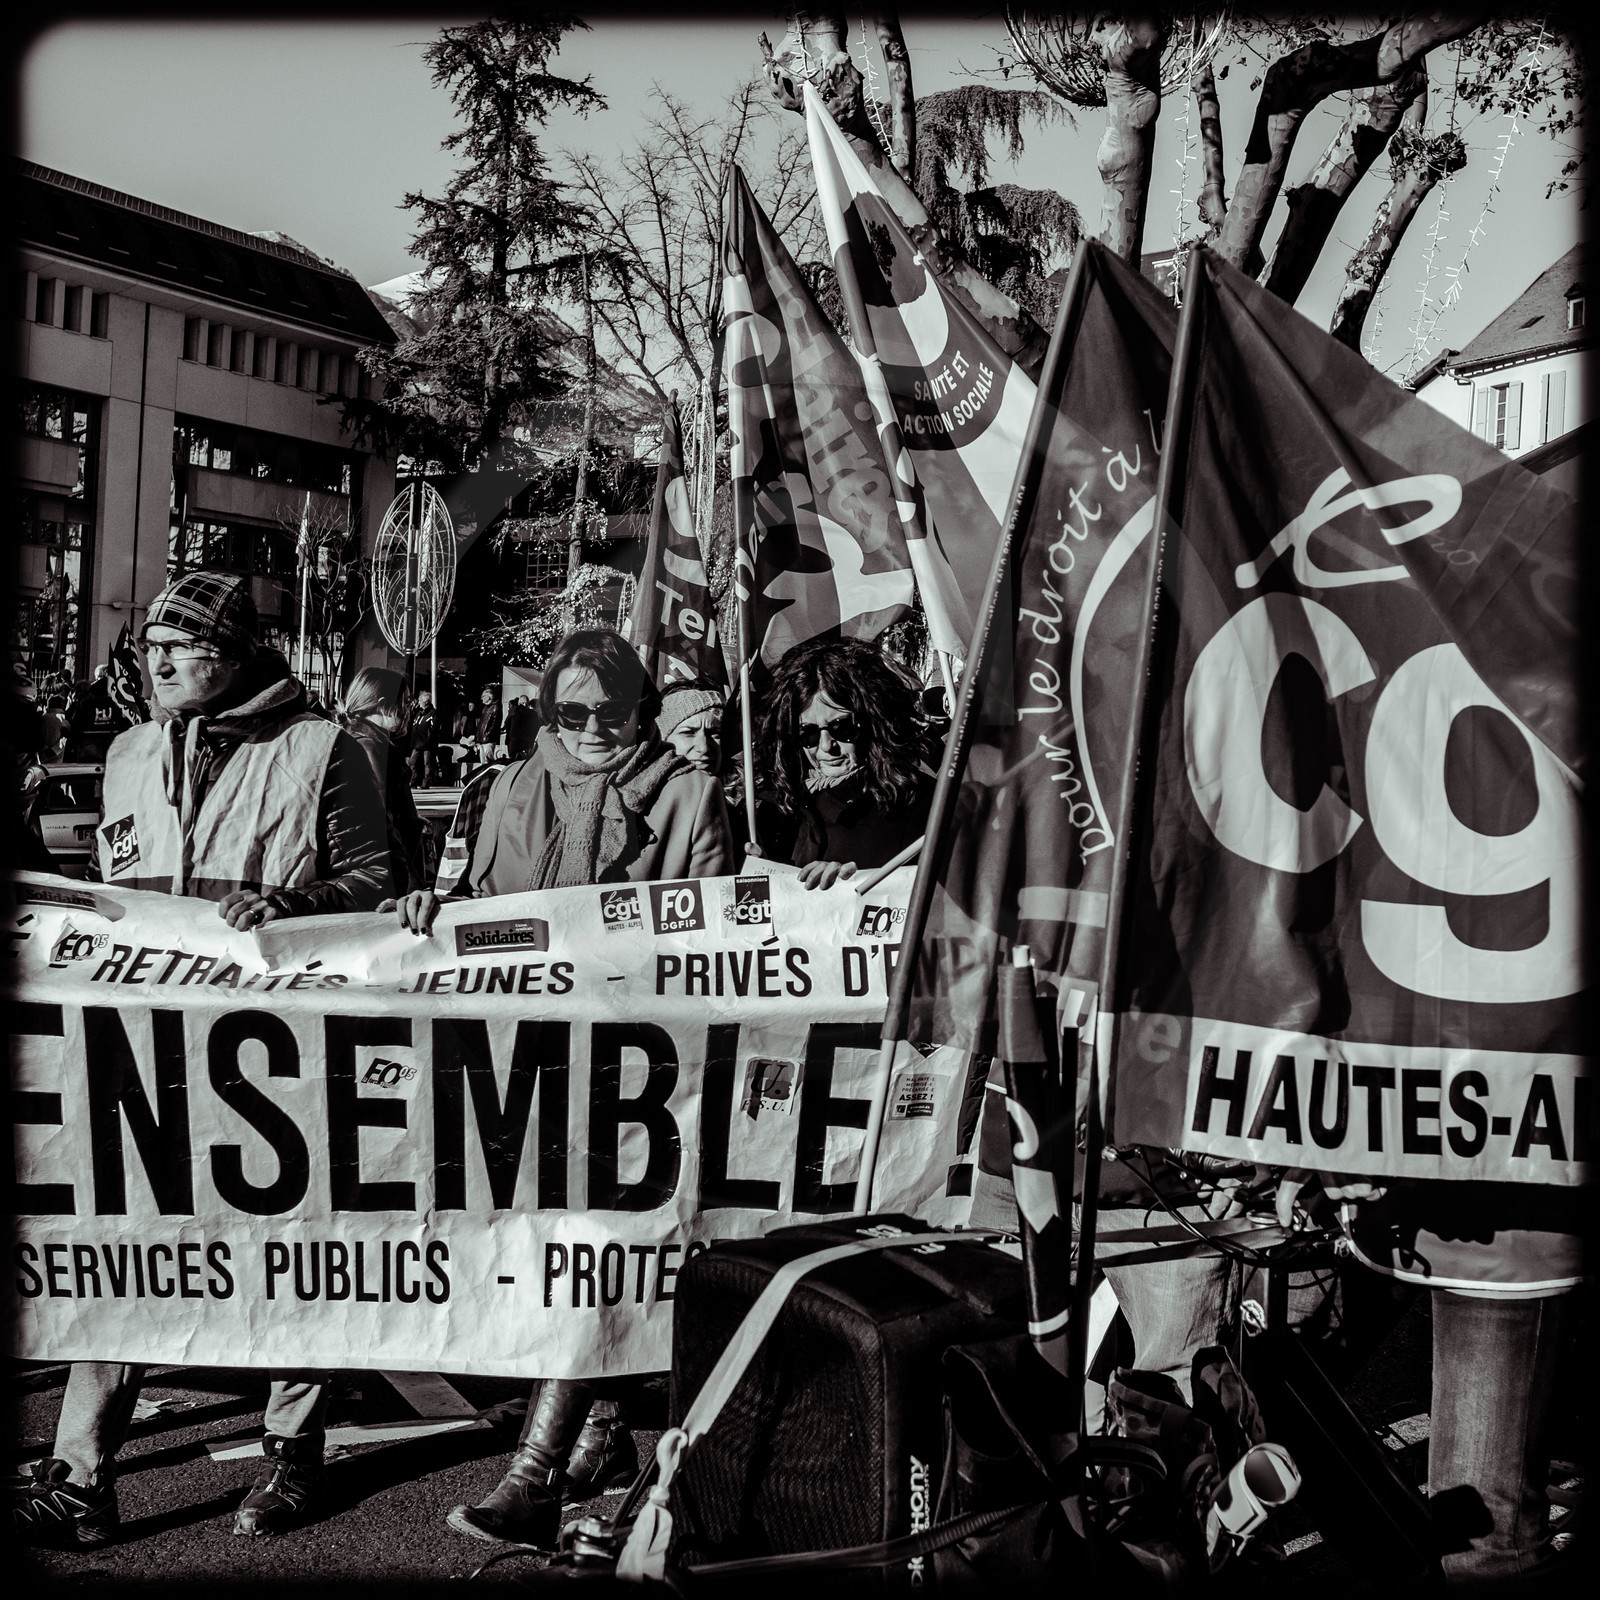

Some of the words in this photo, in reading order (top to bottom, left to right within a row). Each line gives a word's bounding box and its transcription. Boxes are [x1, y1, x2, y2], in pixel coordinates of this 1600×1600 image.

[914, 365, 957, 401] SANTÉ
[952, 349, 969, 379] ET
[903, 411, 955, 434] ACTION
[952, 361, 994, 426] SOCIALE
[1101, 443, 1141, 492] à
[1018, 480, 1103, 646] droit
[1017, 657, 1063, 721] le
[1039, 734, 1114, 866] pour
[112, 825, 138, 859] cgt
[603, 890, 630, 905] la
[736, 876, 768, 884] saisonniers
[603, 896, 641, 922] cgt
[660, 887, 696, 922] FO
[736, 899, 773, 924] cgt
[737, 890, 757, 906] la
[464, 928, 535, 947] Solidaires
[607, 923, 625, 932] HAUTES
[399, 961, 575, 995] JEUNES
[656, 935, 813, 998] PRIVÉS
[4, 1001, 885, 1217] ENSEMBLE
[899, 1093, 928, 1101] ASSEZ
[14, 1242, 235, 1301] SERVICES
[264, 1240, 451, 1305] PUBLICS
